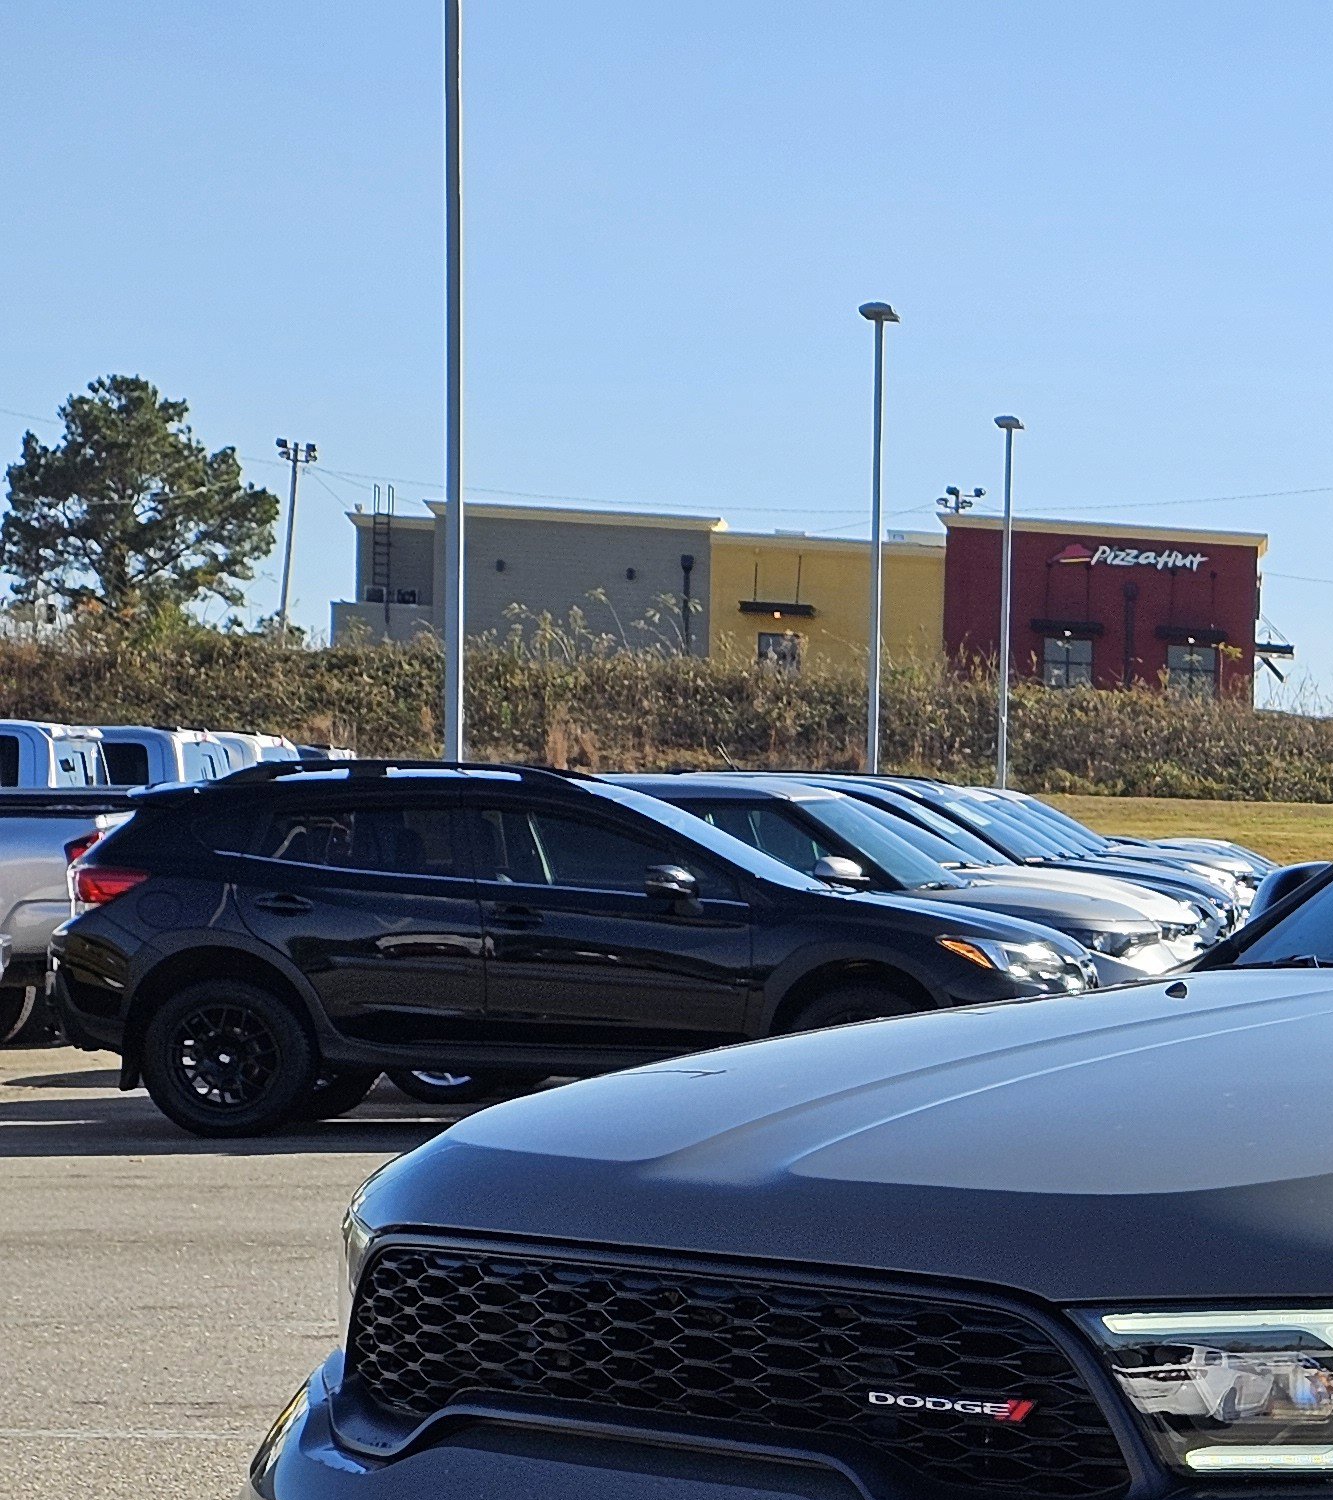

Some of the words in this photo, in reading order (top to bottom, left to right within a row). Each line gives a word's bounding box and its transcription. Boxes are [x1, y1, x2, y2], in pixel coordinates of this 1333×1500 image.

[1091, 545, 1157, 566] Pizza
[1156, 549, 1210, 572] Hut
[868, 1391, 1011, 1416] DODGE
